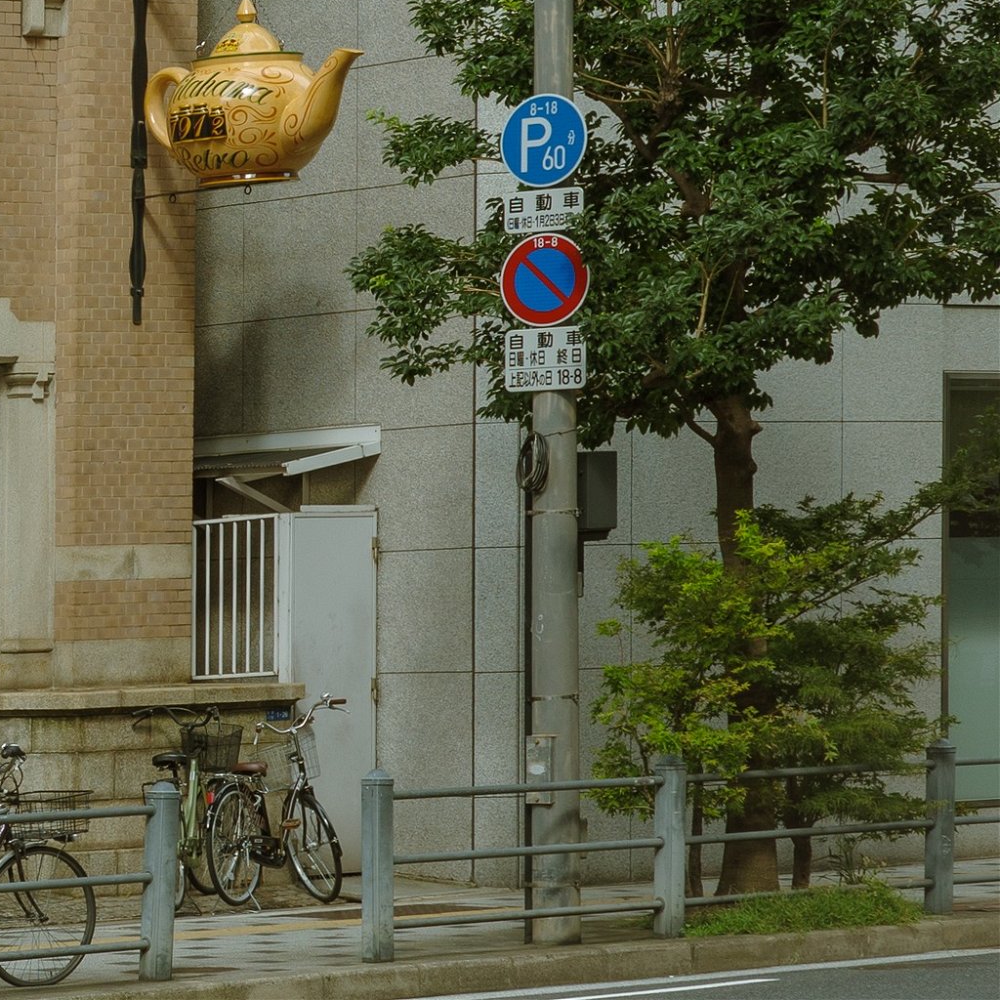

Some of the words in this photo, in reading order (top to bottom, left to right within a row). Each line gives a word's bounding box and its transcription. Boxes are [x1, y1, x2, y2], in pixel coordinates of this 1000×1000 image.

[530, 101, 558, 116] 8-18
[170, 114, 224, 140] 1912
[520, 116, 552, 173] P
[542, 145, 566, 170] 60
[568, 130, 575, 145] 分
[179, 148, 249, 175] Retro
[509, 191, 580, 213] 自動車
[533, 237, 558, 248] 18-8
[509, 330, 582, 349] 自動車
[557, 368, 582, 385] 18-8
